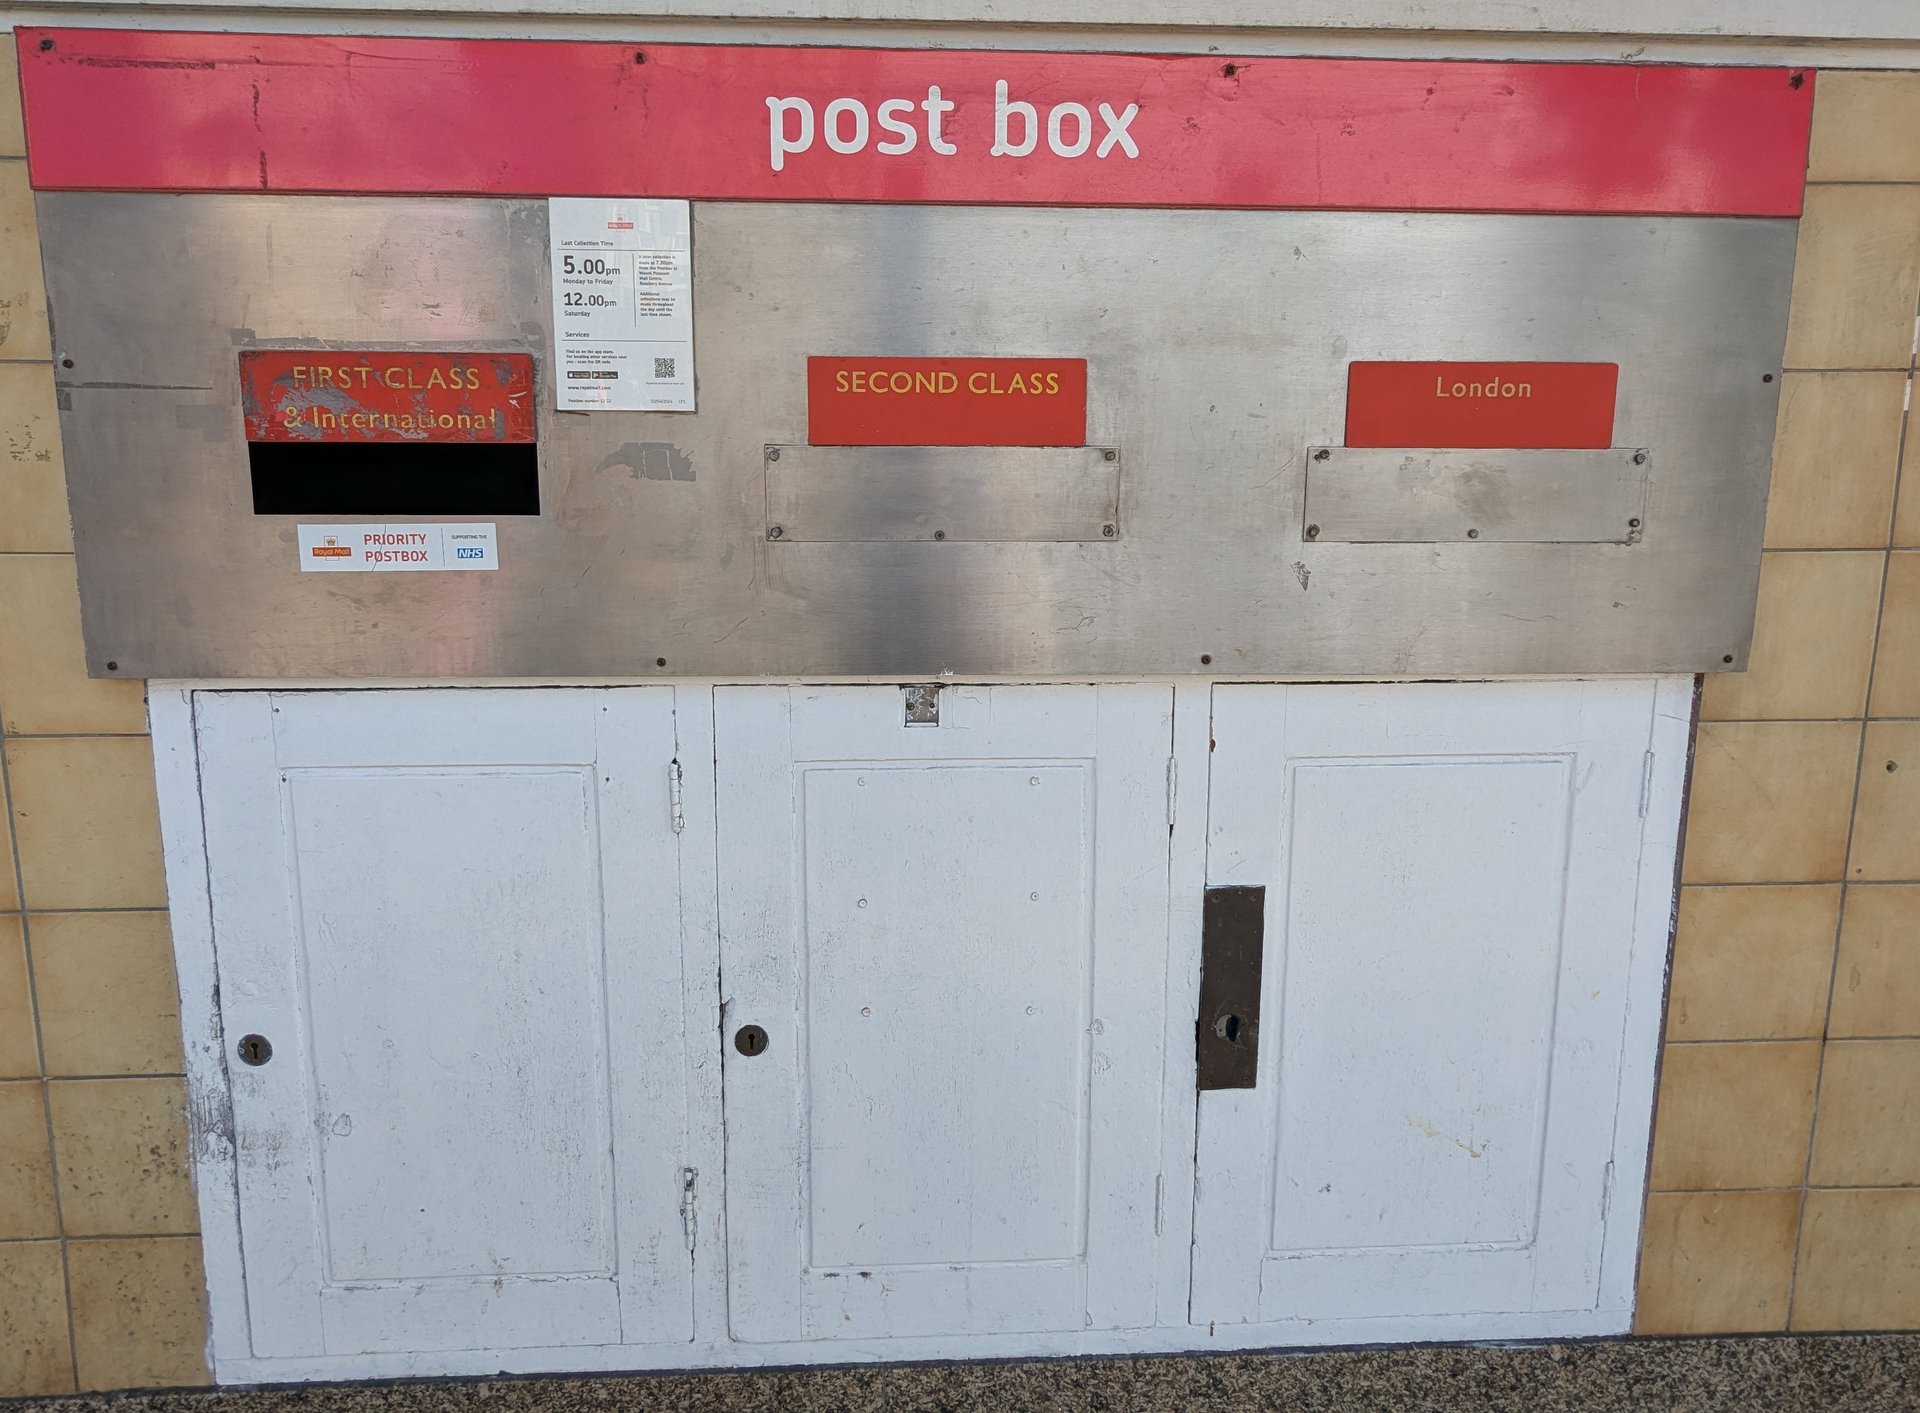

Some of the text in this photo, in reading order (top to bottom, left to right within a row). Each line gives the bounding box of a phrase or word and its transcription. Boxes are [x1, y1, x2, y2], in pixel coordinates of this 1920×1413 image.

[765, 79, 1140, 171] post box
[563, 255, 621, 276] 5.00pm
[563, 292, 617, 308] 12.00pm
[292, 366, 481, 390] FIRST CLASS
[836, 371, 1060, 395] SECOND CLASS
[1436, 376, 1532, 398] London
[283, 406, 497, 429] & International
[363, 534, 427, 546] PRIORITY
[334, 548, 350, 556] Mail
[365, 551, 428, 563] POSTBOX
[458, 549, 483, 559] NHS
